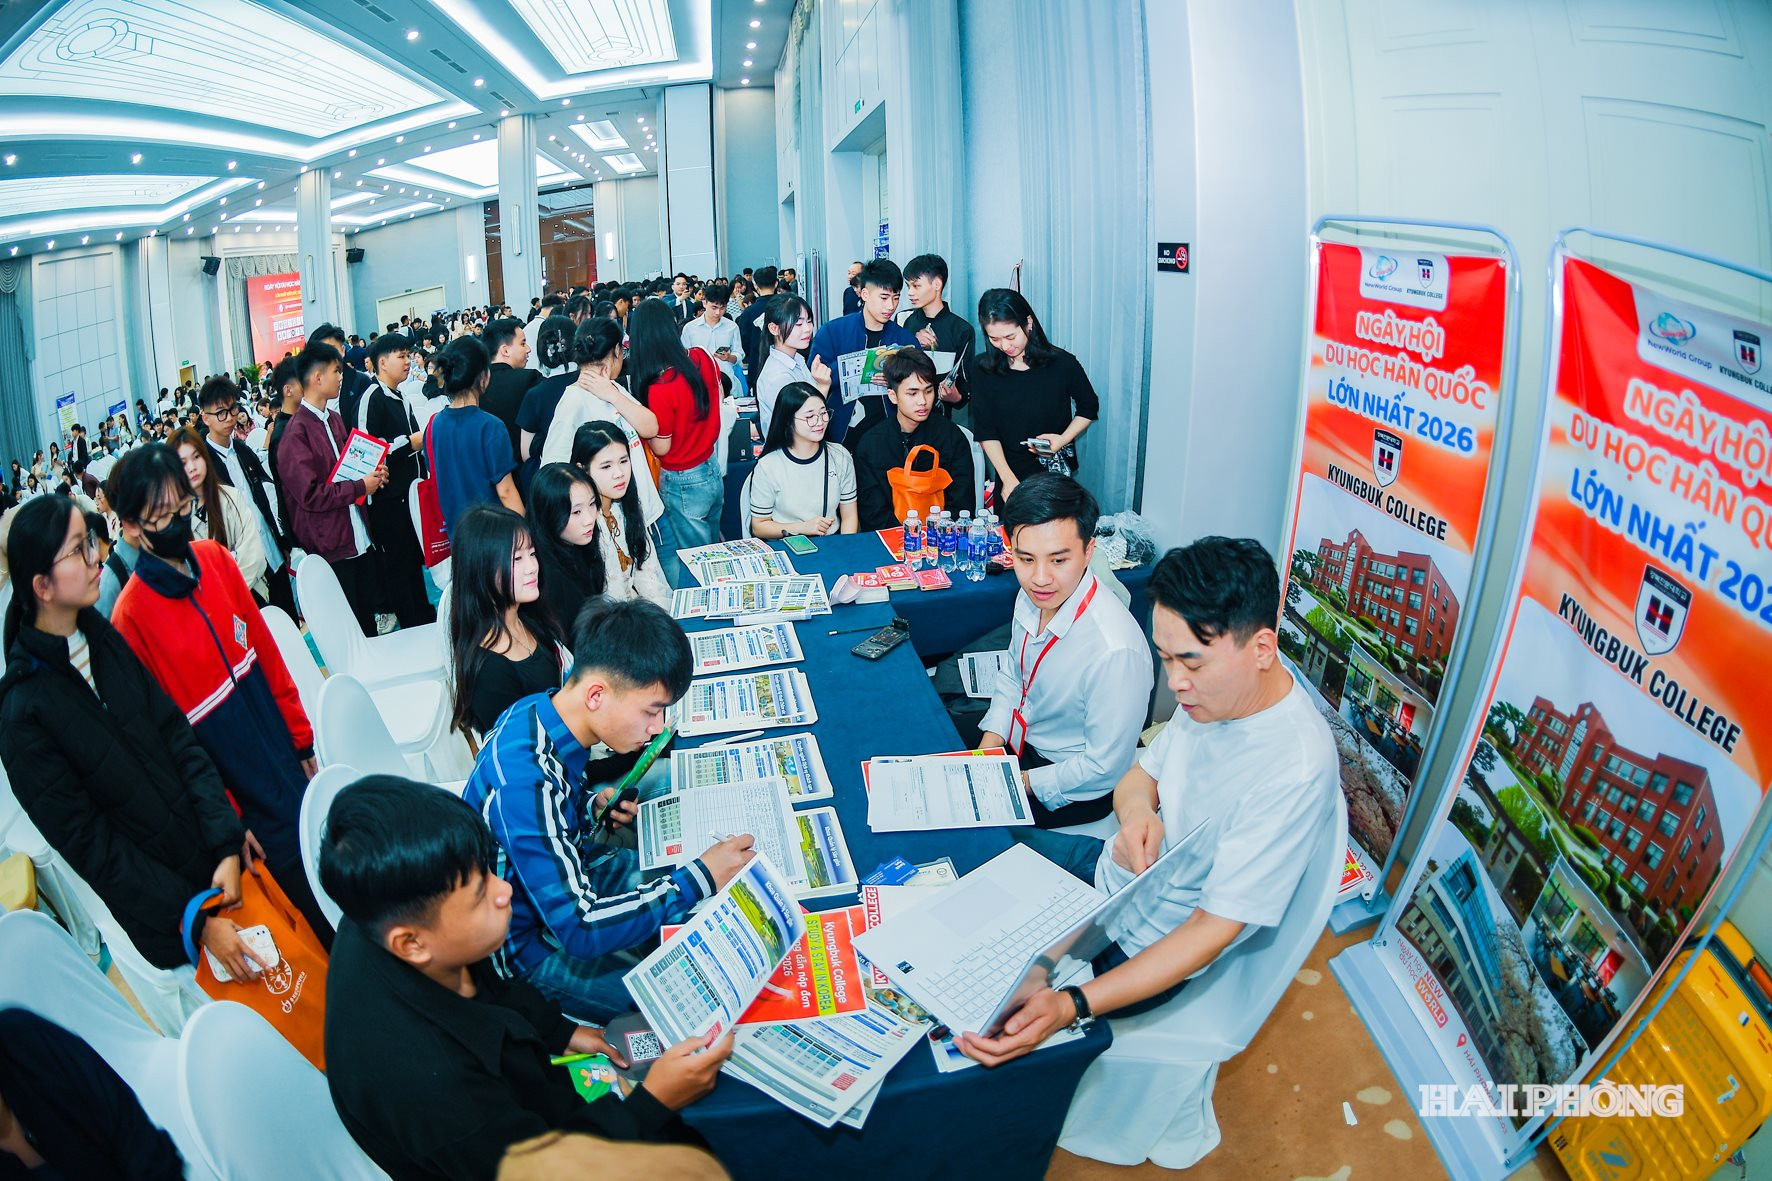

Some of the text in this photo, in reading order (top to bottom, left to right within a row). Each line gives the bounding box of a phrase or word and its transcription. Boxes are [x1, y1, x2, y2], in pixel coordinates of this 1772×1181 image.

[1406, 288, 1443, 300] KYUNGBUK COLLEGE
[1359, 313, 1441, 357] NGÀY HỘI
[1648, 339, 1712, 370] NewWorld Group
[1326, 344, 1486, 410] DU HỌC HÀN QUỐC
[1719, 365, 1753, 386] KYUNGBUK
[1328, 376, 1473, 452] LỚN NHẤT 2026
[1630, 386, 1718, 446] NGÀY
[1571, 413, 1598, 450] DU
[1604, 431, 1667, 484] HỌC
[1670, 464, 1737, 524] HÀN
[1328, 464, 1447, 541] KYUNGBUK COLLEGE
[1571, 467, 1623, 526] LỚN
[1628, 503, 1719, 581] NHẤT
[1558, 593, 1740, 754] KYUNGBUK COLLEGE
[867, 887, 879, 928] COLLEGE
[807, 920, 821, 944] STUDY
[782, 956, 793, 976] 2026
[812, 953, 825, 971] STAY
[824, 922, 847, 1004] Kyungbuk College
[1399, 952, 1409, 965] du
[796, 972, 808, 988] nộp
[817, 984, 832, 1011] KOREA
[1424, 971, 1444, 999] NEW
[801, 990, 811, 1008] đơn
[1416, 979, 1446, 1025] WORLD
